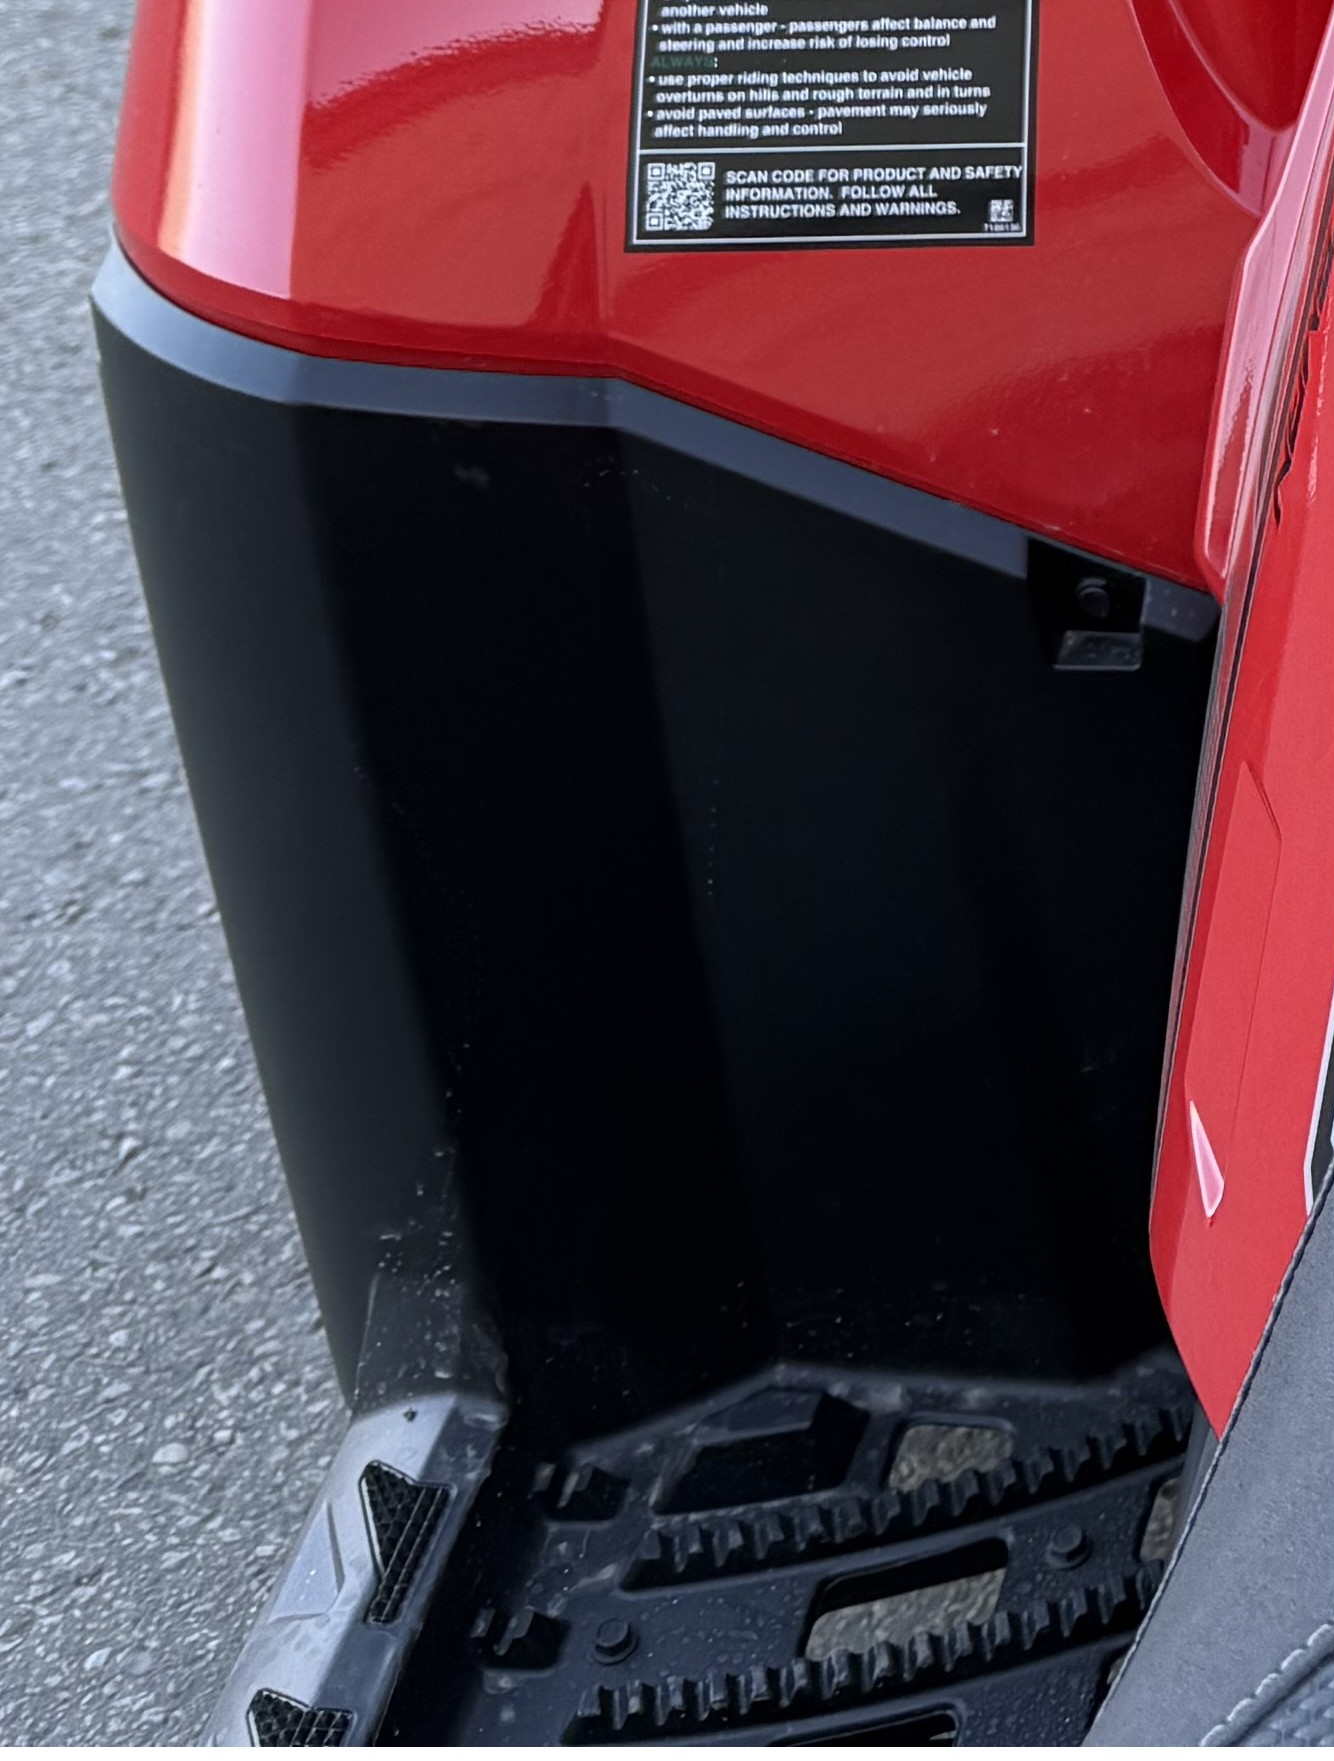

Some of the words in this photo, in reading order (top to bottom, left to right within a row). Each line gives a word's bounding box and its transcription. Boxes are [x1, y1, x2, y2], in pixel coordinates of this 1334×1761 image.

[661, 4, 715, 17] another
[720, 3, 768, 16] vehicle
[659, 75, 683, 85] use
[687, 74, 733, 87] proper
[738, 71, 778, 87] riding
[782, 70, 859, 86] techniques
[863, 70, 877, 82] to
[881, 68, 918, 81] avoid
[923, 68, 972, 80] vehicle
[726, 171, 767, 184] SCAN
[772, 170, 813, 182] CODE
[819, 169, 848, 182] FOR
[854, 167, 926, 181] PRODUCT
[930, 167, 961, 179] AND
[966, 165, 1022, 179] SAFETY
[726, 187, 832, 201] INFORMATION.
[841, 186, 905, 199] FOLLOW
[910, 185, 937, 198] ALL
[726, 204, 836, 219] INSTRUCTIONS
[840, 203, 871, 216] AND
[876, 202, 960, 215] WARNINGS.
